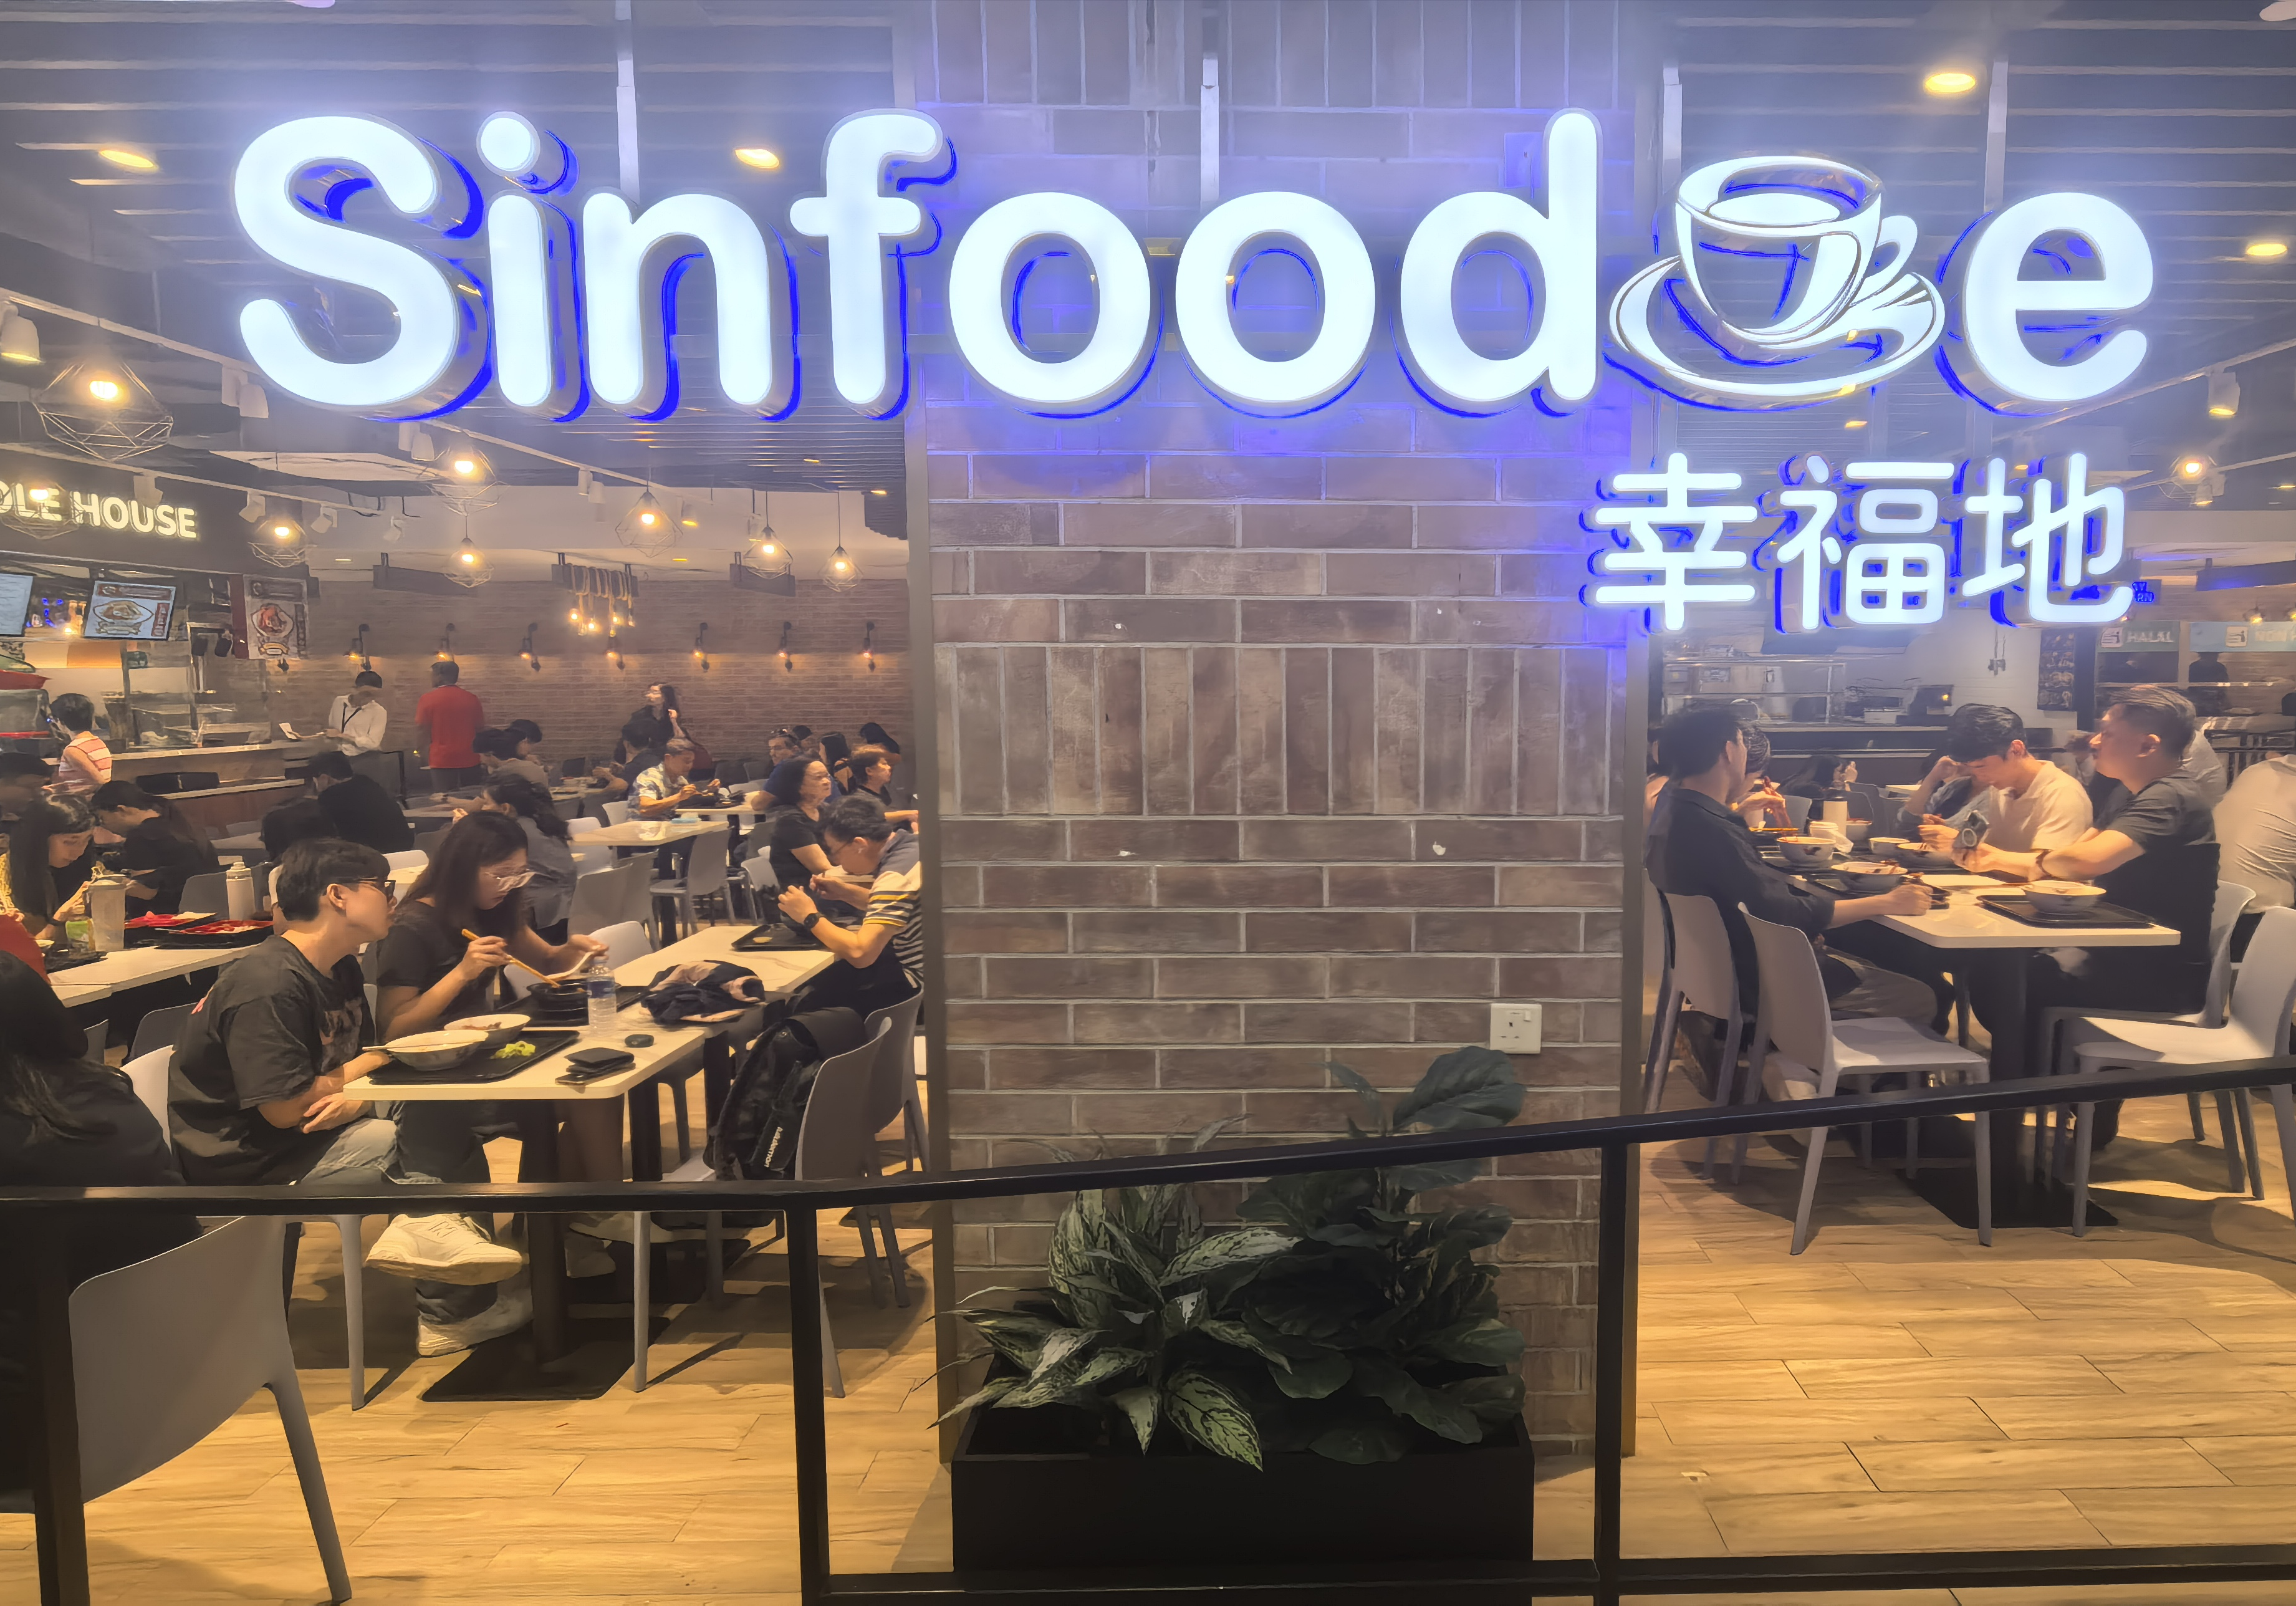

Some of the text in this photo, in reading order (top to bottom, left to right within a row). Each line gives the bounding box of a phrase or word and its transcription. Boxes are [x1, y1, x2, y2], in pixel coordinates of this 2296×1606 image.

[70, 491, 198, 539] HOUSE
[1594, 452, 2135, 631] 幸福地
